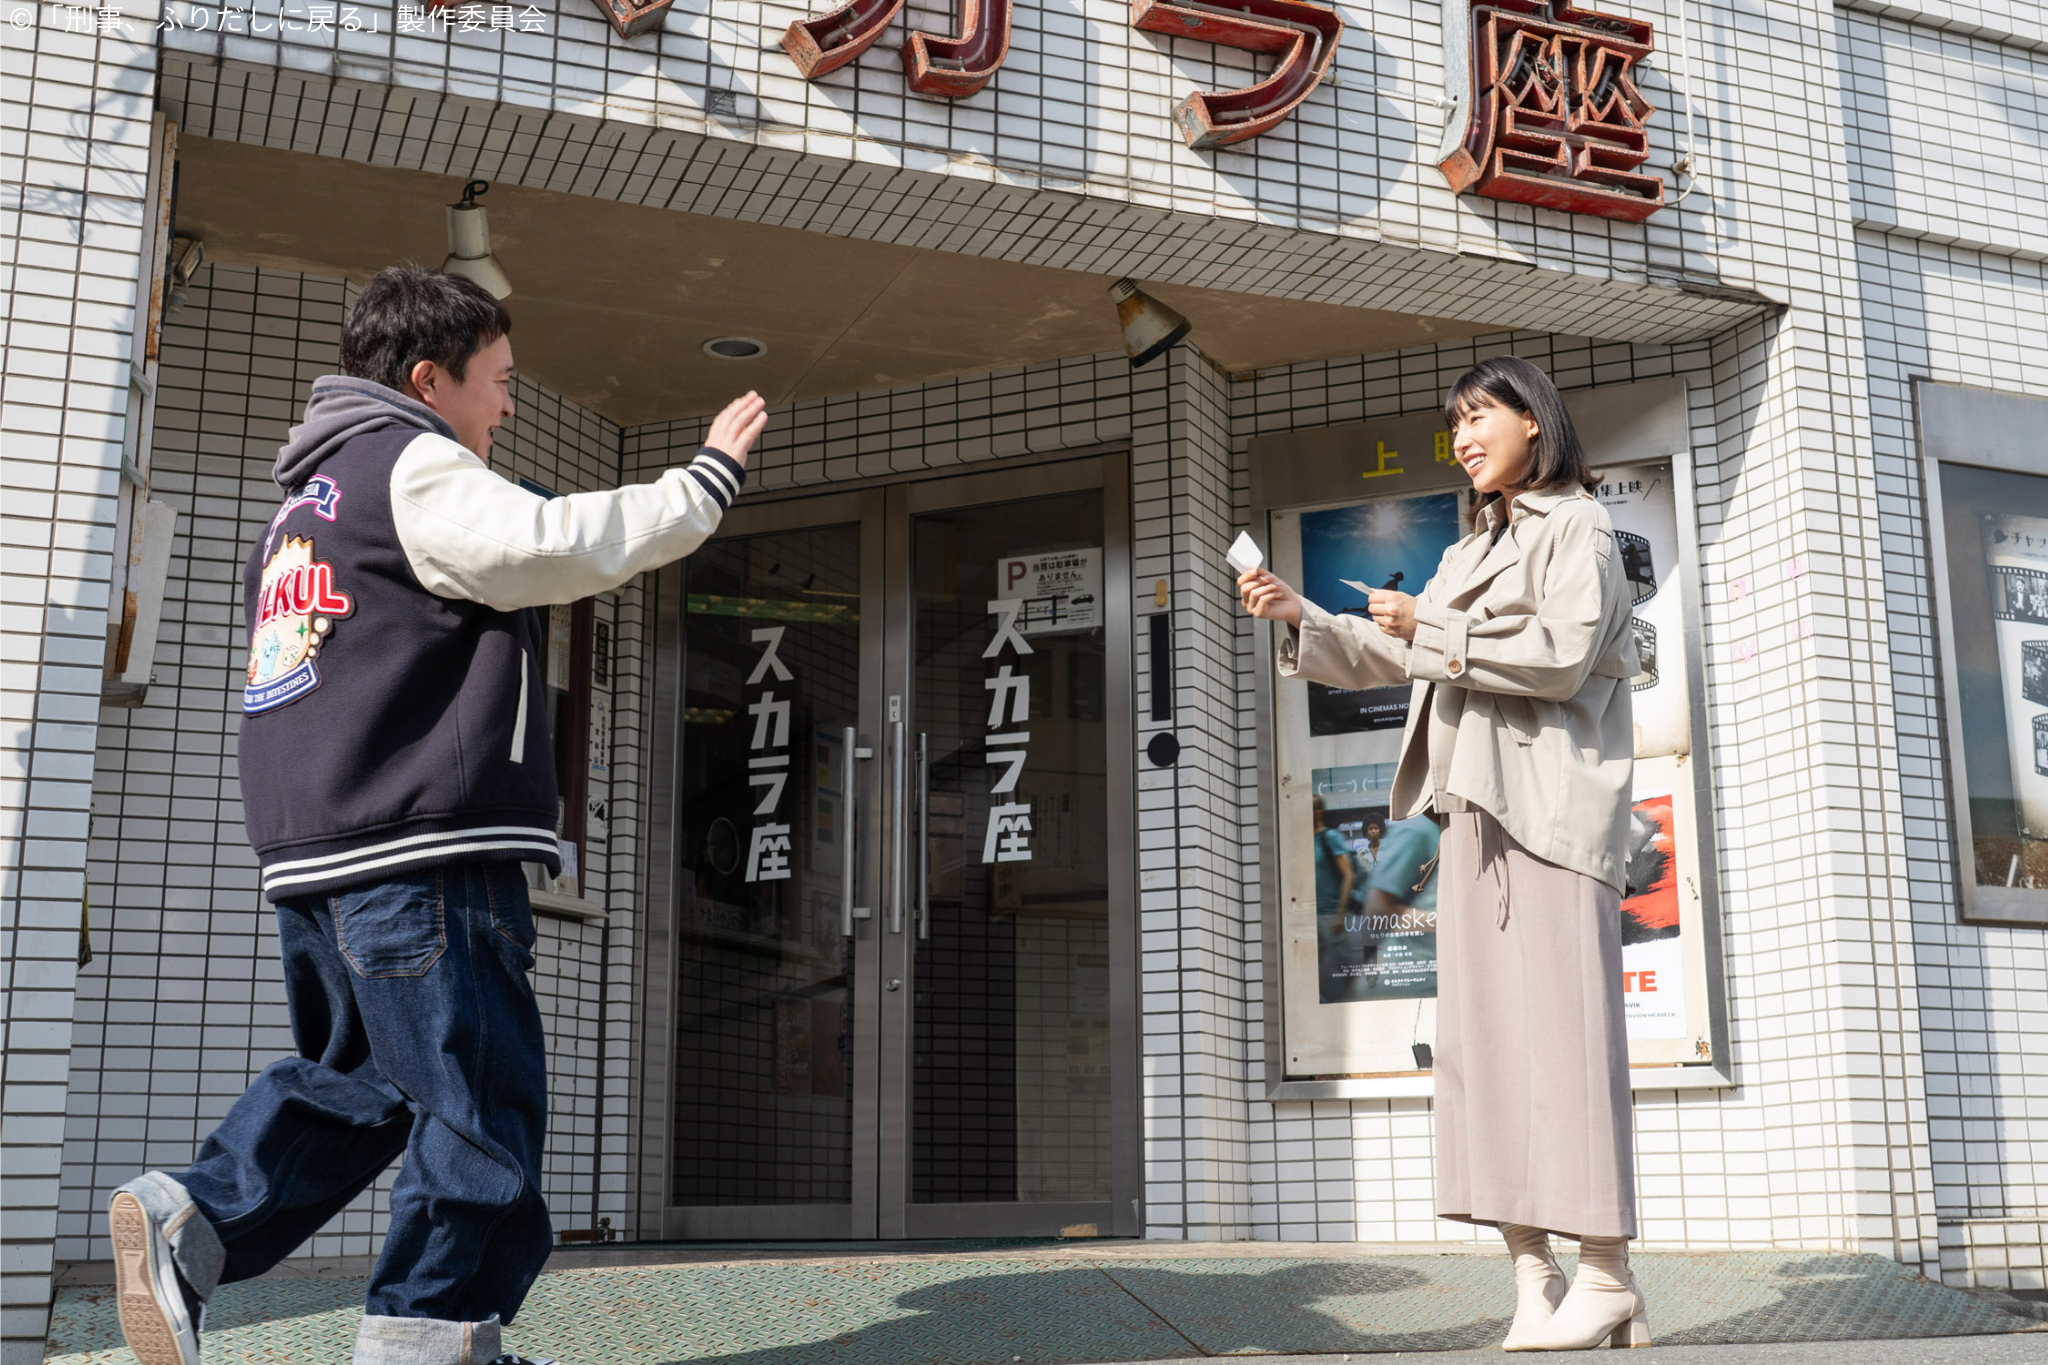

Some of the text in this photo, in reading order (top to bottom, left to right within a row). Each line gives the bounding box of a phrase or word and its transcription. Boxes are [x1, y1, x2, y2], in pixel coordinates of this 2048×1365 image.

[1007, 561, 1027, 591] P
[1368, 703, 1398, 713] CINEMAS
[1399, 702, 1411, 710] NO
[981, 598, 1035, 864] スカラ座
[745, 626, 795, 883] スカラ座
[1344, 908, 1437, 932] unmaske
